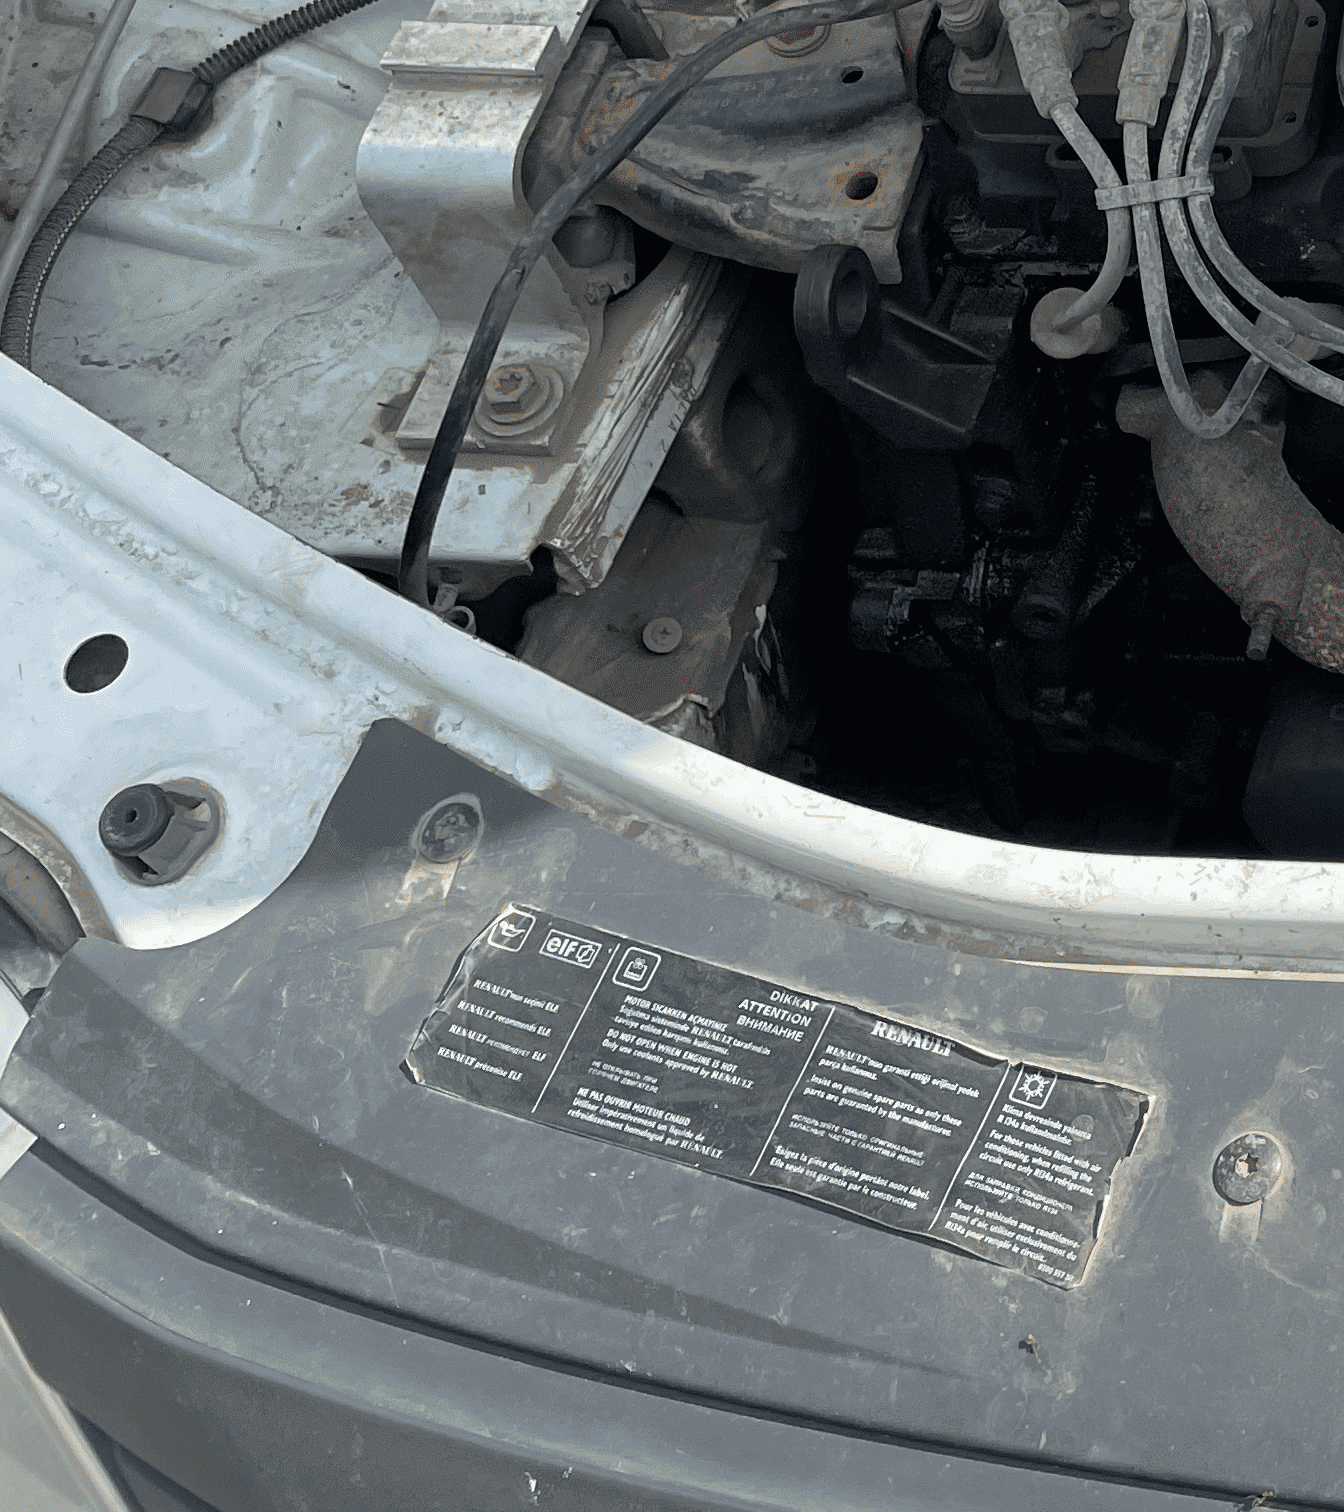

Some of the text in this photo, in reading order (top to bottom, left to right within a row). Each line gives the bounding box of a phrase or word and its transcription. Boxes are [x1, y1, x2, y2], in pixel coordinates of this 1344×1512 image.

[546, 937, 579, 957] elf
[457, 1000, 497, 1019] RENAULT
[737, 998, 812, 1027] ATTENTION
[736, 1014, 805, 1043] ВНИМАНИЕ
[872, 1020, 956, 1057] RENAULT
[437, 1046, 477, 1066] RENAULT
